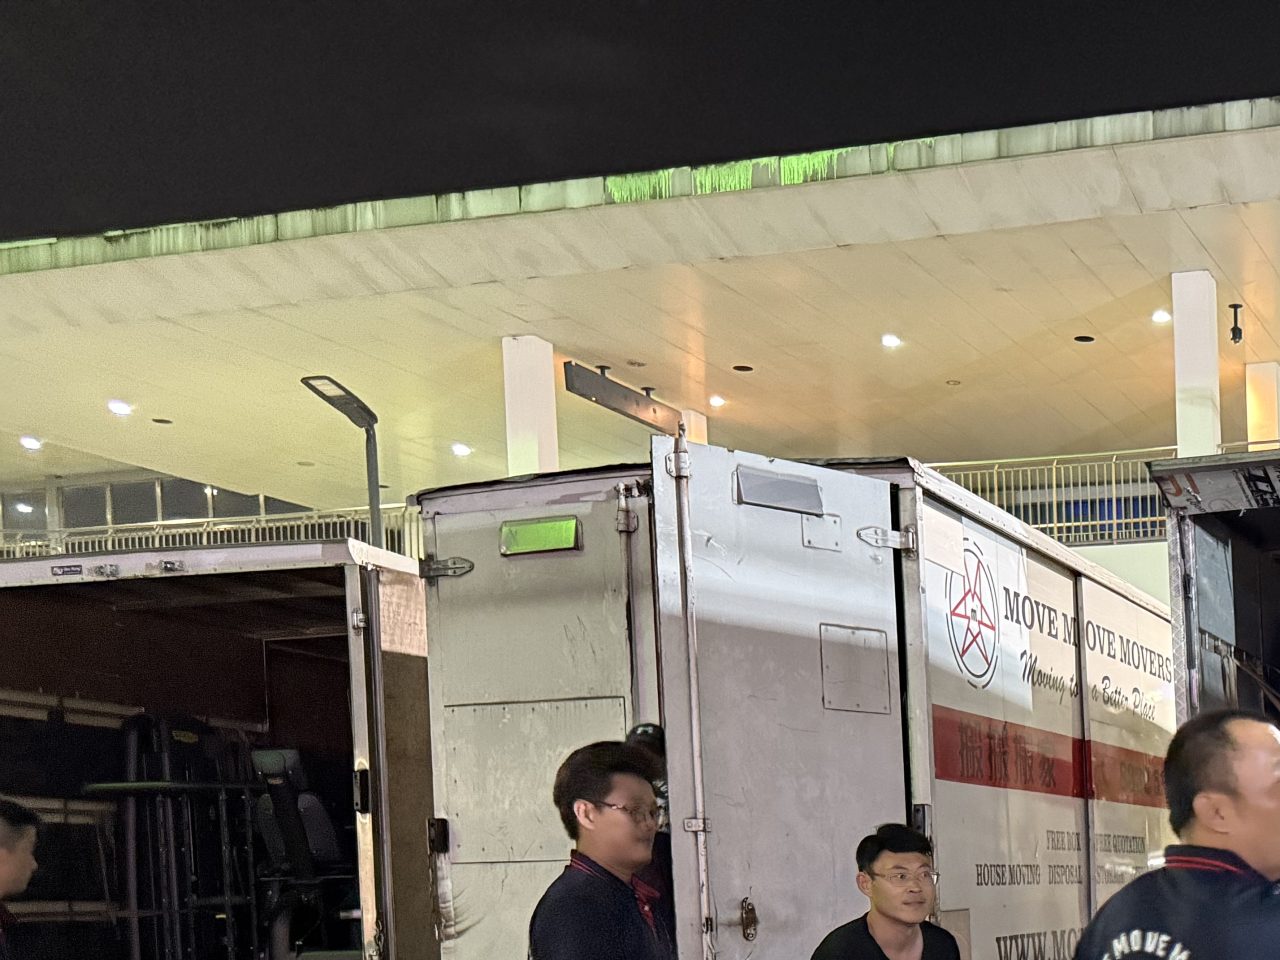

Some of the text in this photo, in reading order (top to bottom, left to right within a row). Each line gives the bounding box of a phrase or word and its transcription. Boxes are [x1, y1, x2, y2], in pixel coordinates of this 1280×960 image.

[1003, 586, 1059, 640] MOVE
[1119, 634, 1172, 684] MOVERS
[1020, 649, 1155, 721] Moving to a Better Place
[1046, 830, 1081, 852] FREE BOX
[1113, 834, 1146, 854] QUOTATION
[976, 864, 1041, 886] HOUSE MOVING
[1048, 865, 1083, 885] DISPOSAL
[1112, 929, 1172, 960] MOVE
